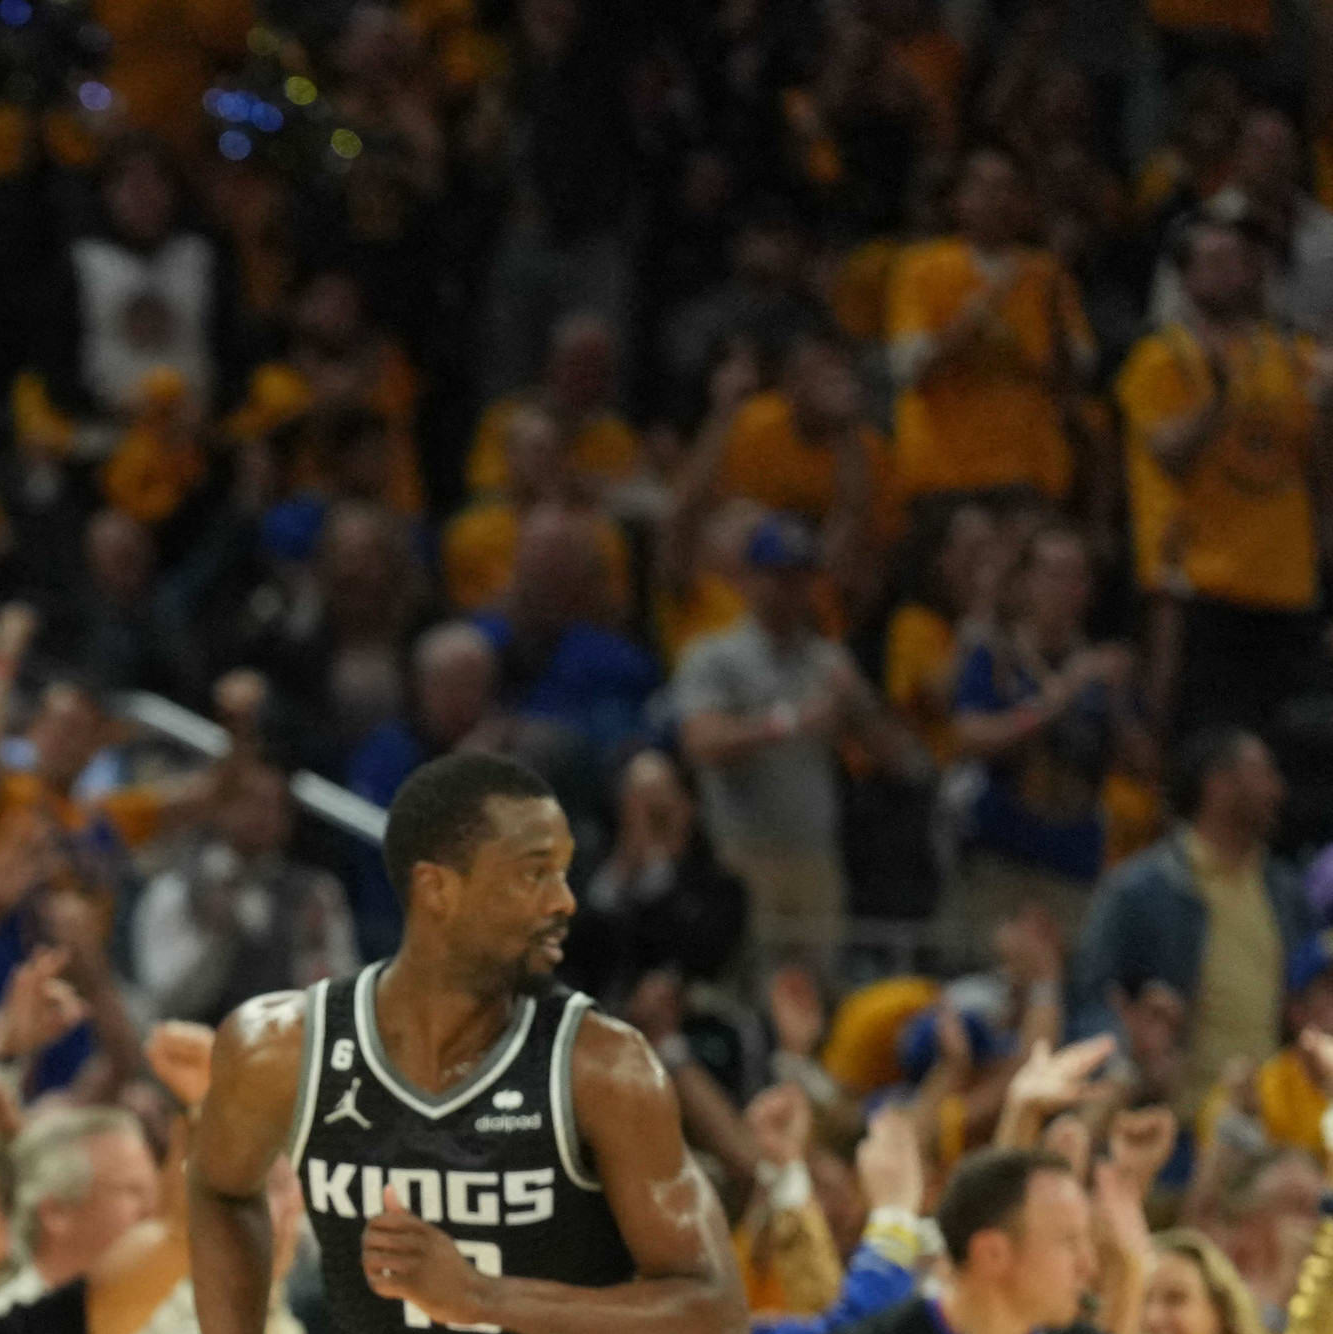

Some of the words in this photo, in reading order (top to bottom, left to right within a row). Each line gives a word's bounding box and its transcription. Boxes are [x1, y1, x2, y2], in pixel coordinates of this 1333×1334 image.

[331, 1039, 355, 1070] 6
[475, 1112, 542, 1133] dialpad
[308, 1158, 555, 1225] KINGS
